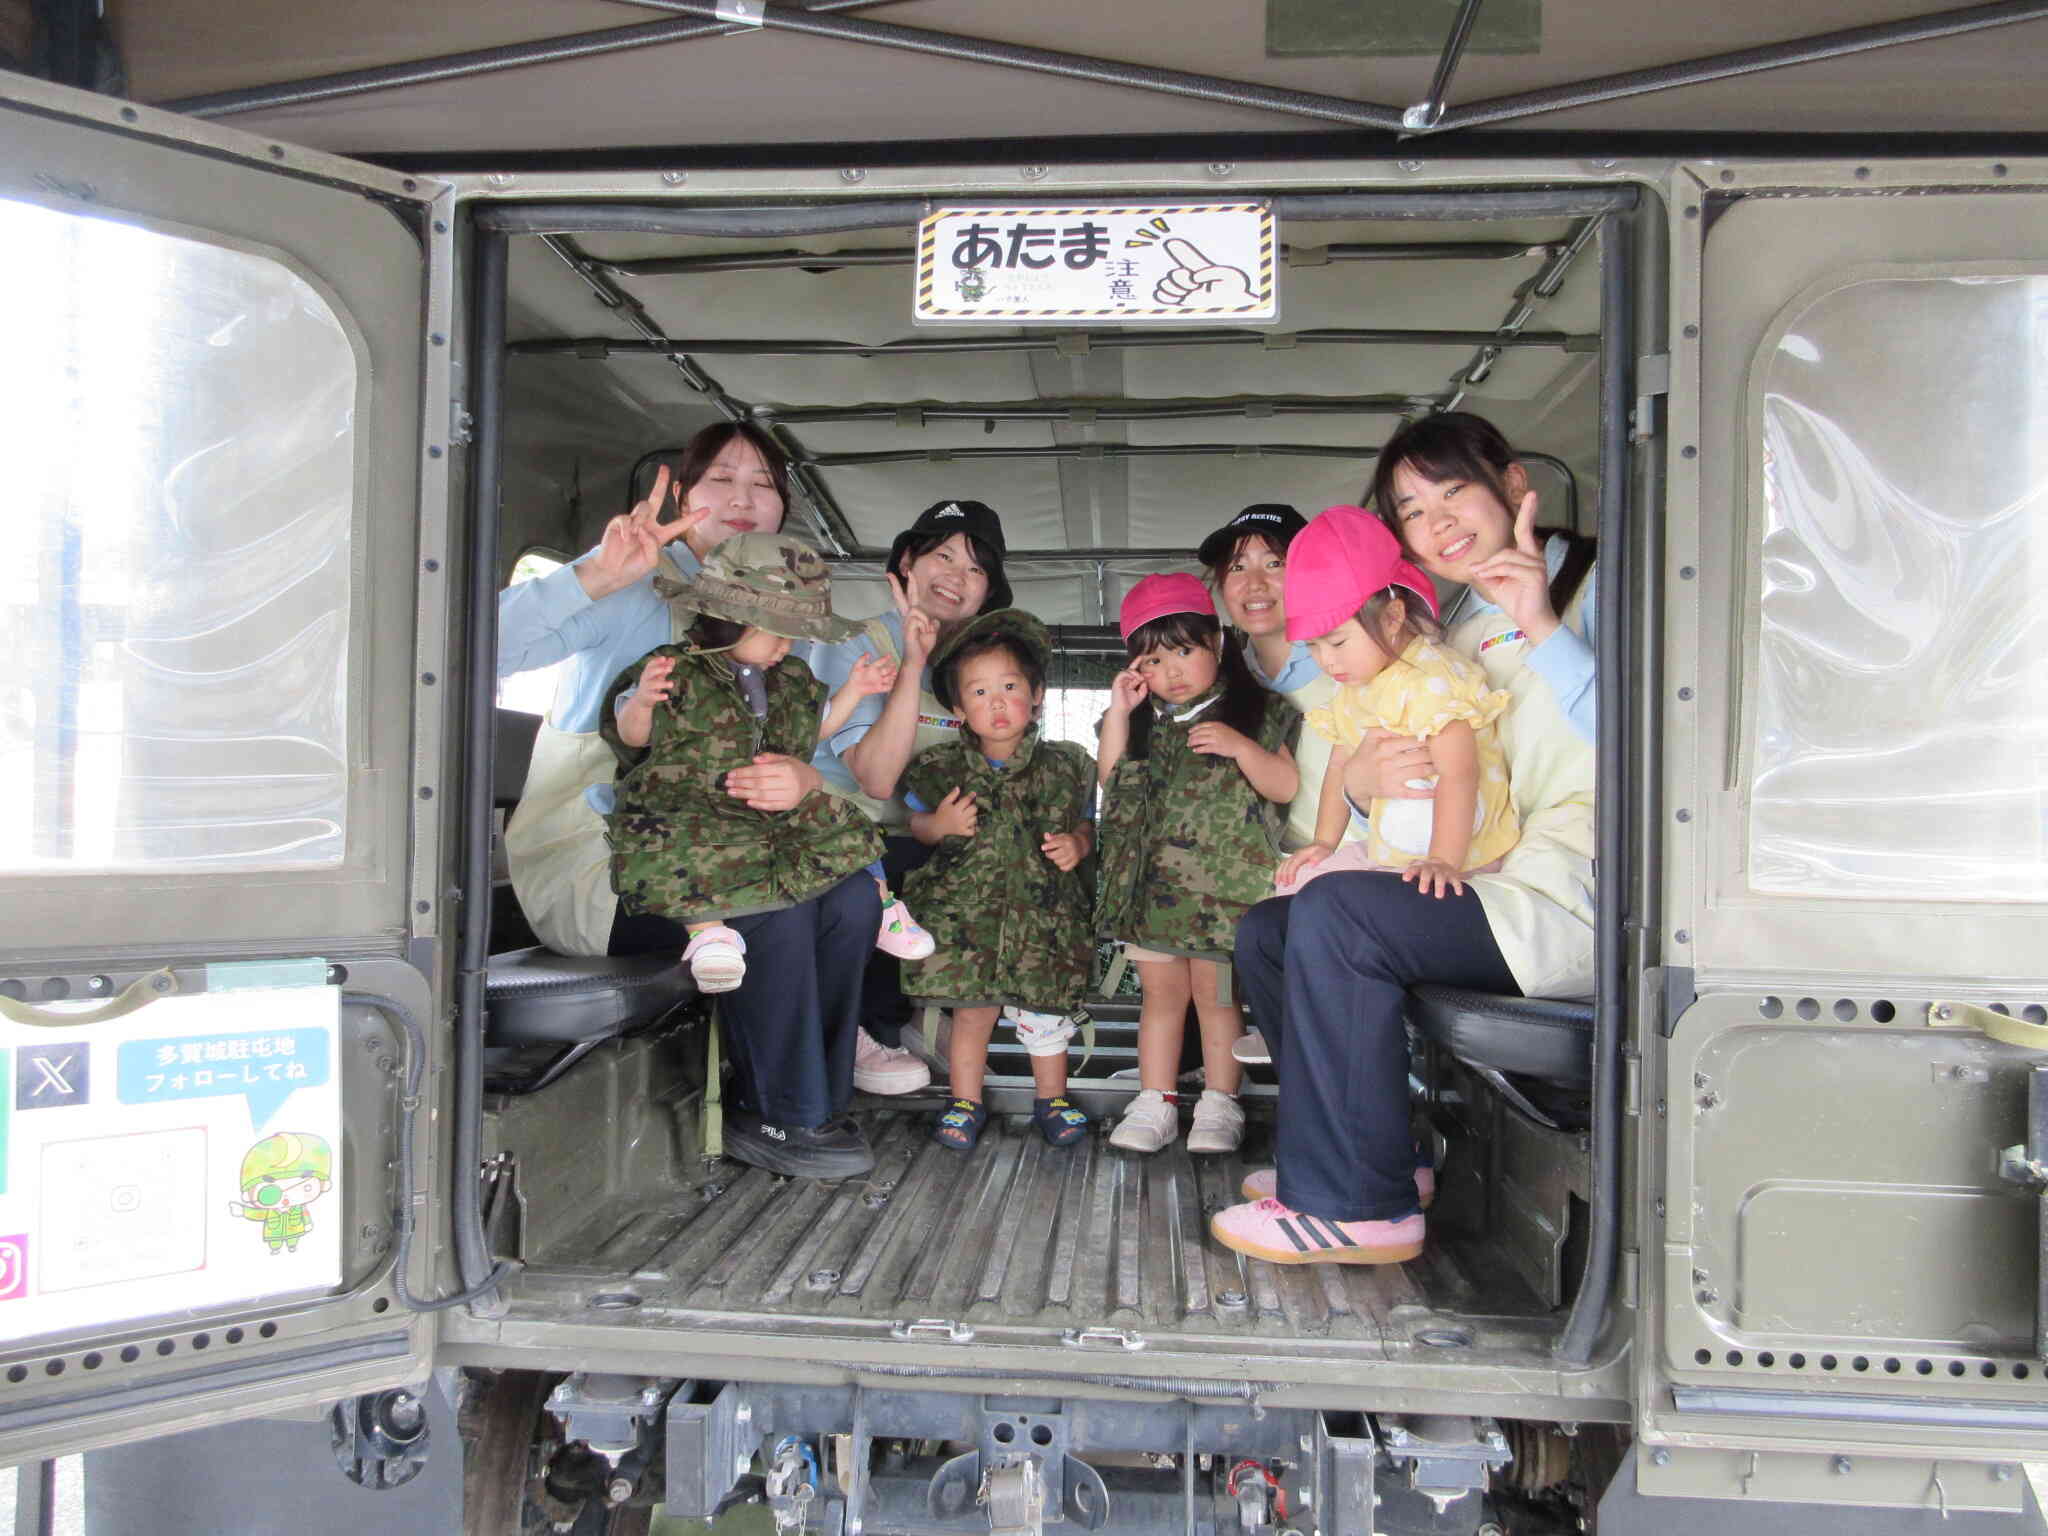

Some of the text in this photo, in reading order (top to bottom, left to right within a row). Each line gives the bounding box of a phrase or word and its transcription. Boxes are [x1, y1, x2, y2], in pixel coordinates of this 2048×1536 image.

[952, 222, 1111, 270] あたま
[1104, 258, 1140, 301] 注意
[144, 1060, 309, 1093] フォローしてね
[761, 1124, 786, 1141] FILA
